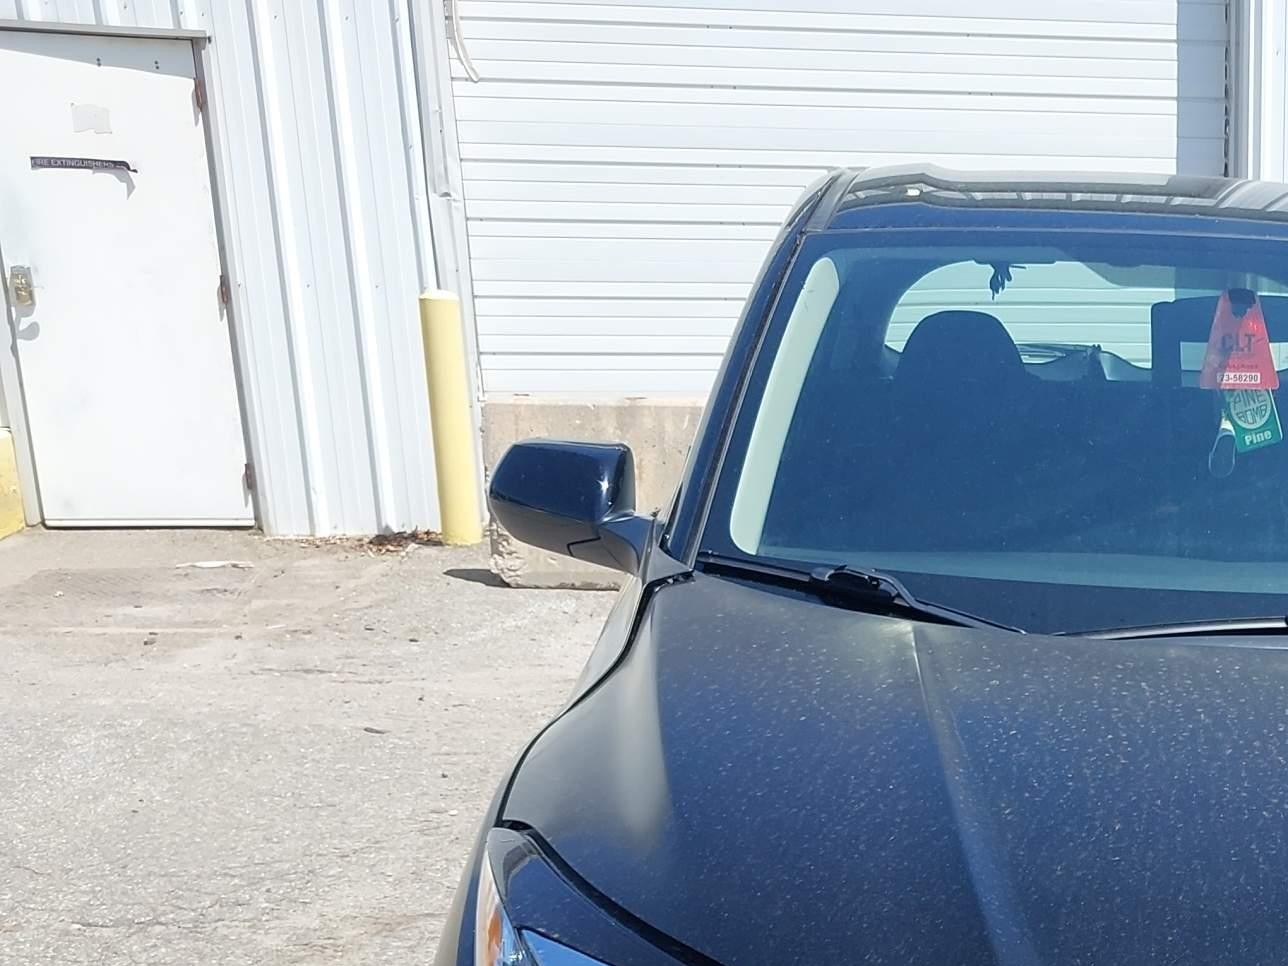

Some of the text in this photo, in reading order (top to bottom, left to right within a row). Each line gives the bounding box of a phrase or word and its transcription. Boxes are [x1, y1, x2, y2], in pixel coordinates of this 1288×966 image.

[1233, 389, 1267, 411] PINE
[1236, 404, 1268, 425] BOMB
[1244, 430, 1272, 446] Pine
